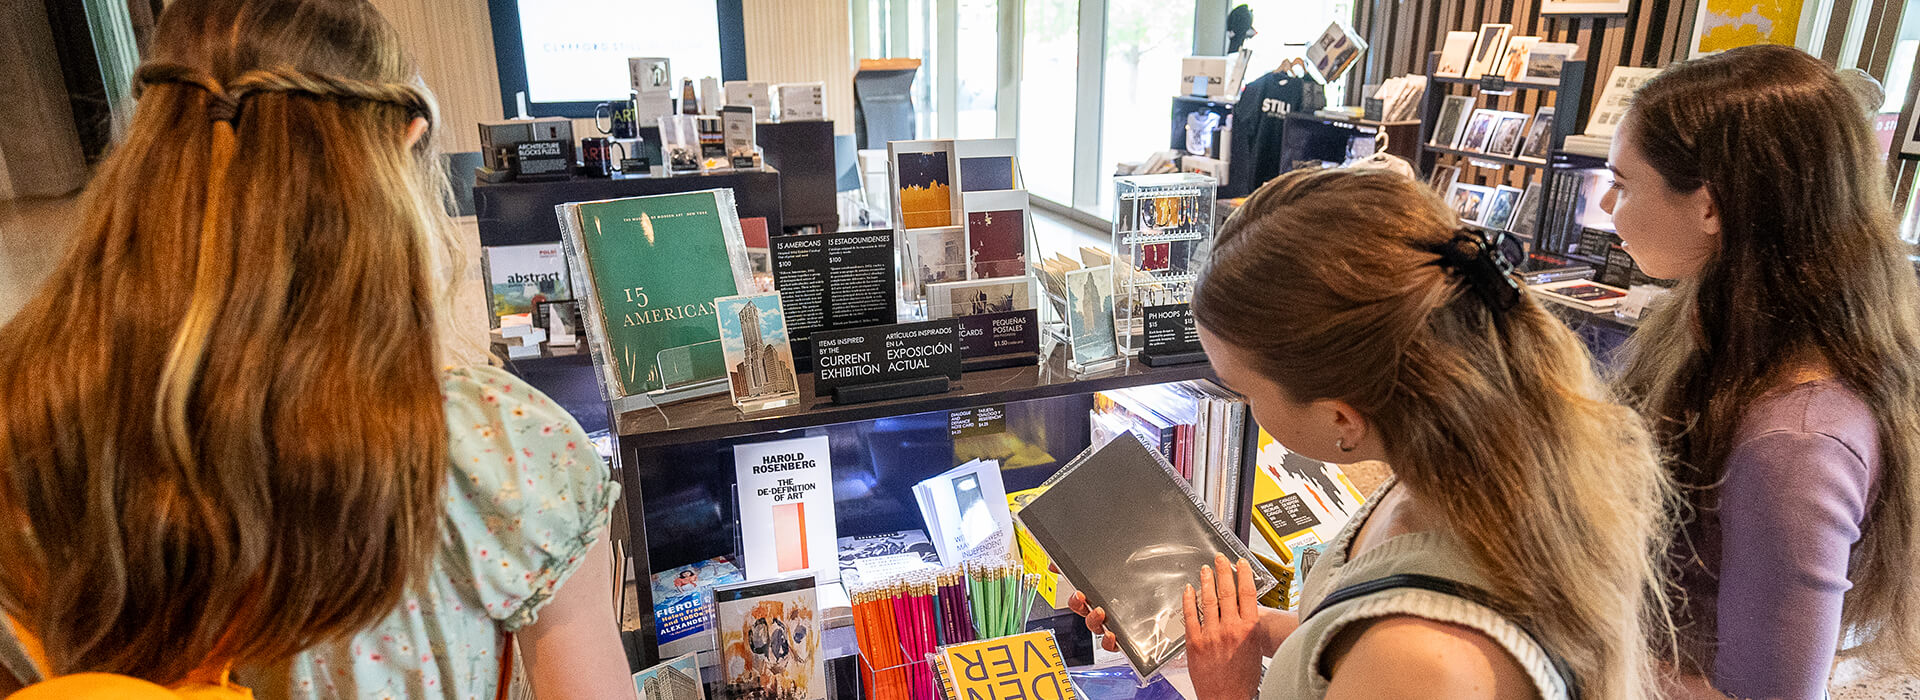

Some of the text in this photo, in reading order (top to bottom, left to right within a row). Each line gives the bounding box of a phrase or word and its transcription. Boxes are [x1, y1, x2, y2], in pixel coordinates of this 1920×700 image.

[518, 142, 560, 150] ARCHITECTURE
[542, 147, 561, 155] PUZZLE
[784, 240, 821, 249] AMERICANS
[835, 235, 890, 245] ESTADOUNIDENSES
[507, 271, 560, 283] abstract
[624, 287, 649, 308] 15
[623, 301, 716, 327] AMERICAN
[1149, 310, 1181, 320] PH HOOPS
[992, 316, 1027, 326] PEQUEÑAS
[885, 327, 952, 340] ARTÍCULOS INSPIRADOS
[992, 324, 1023, 334] POSTALES
[837, 337, 865, 345] INSPIRED
[887, 342, 953, 360] EXPOSICIÓN
[820, 352, 872, 368] CURRENT
[887, 358, 930, 372] ACTUAL
[821, 363, 880, 380] EXHIBITION
[762, 452, 804, 465] HAROLD
[752, 460, 816, 474] ROSENBERG
[777, 478, 794, 486] THE
[757, 483, 816, 496] DE-DEFINITION
[774, 492, 804, 502] OF ART
[662, 612, 684, 622] Helen
[953, 640, 1051, 682] VER
